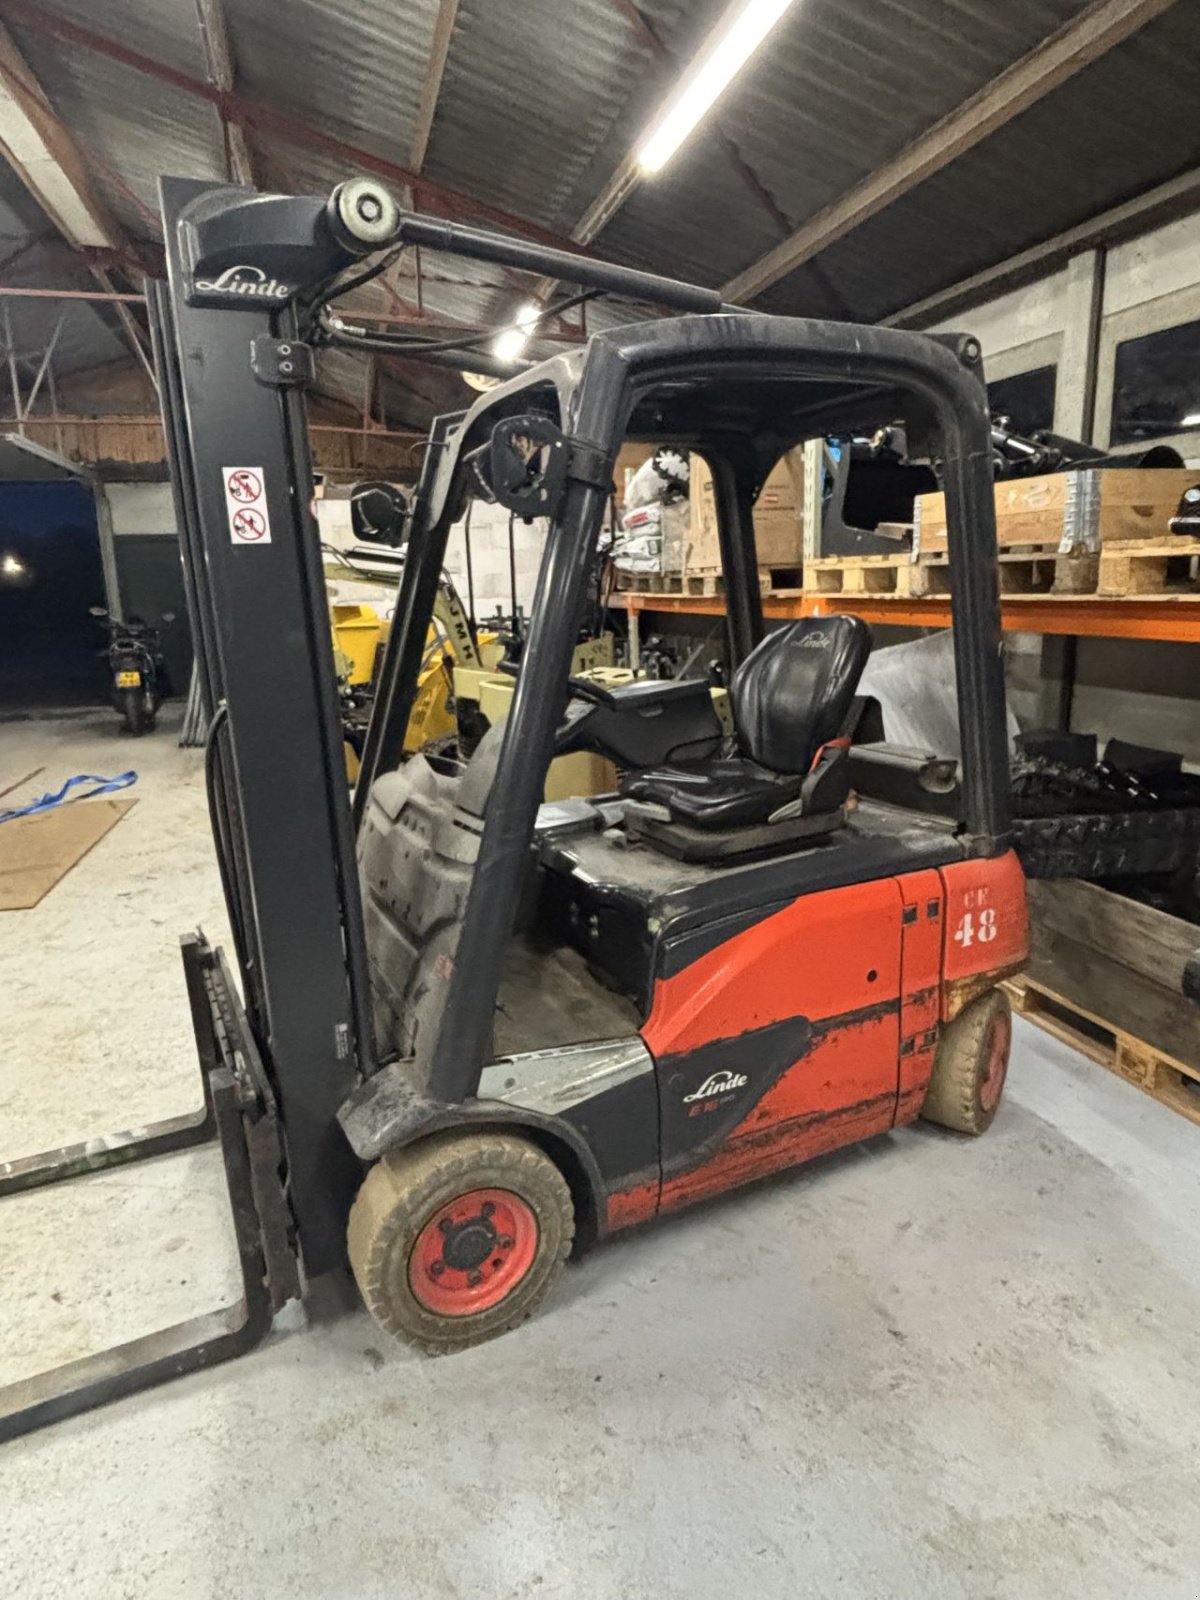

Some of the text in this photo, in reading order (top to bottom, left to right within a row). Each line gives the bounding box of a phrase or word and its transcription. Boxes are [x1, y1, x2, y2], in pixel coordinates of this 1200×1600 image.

[195, 265, 289, 298] Linde
[954, 908, 997, 948] 48
[683, 1070, 748, 1103] Linde
